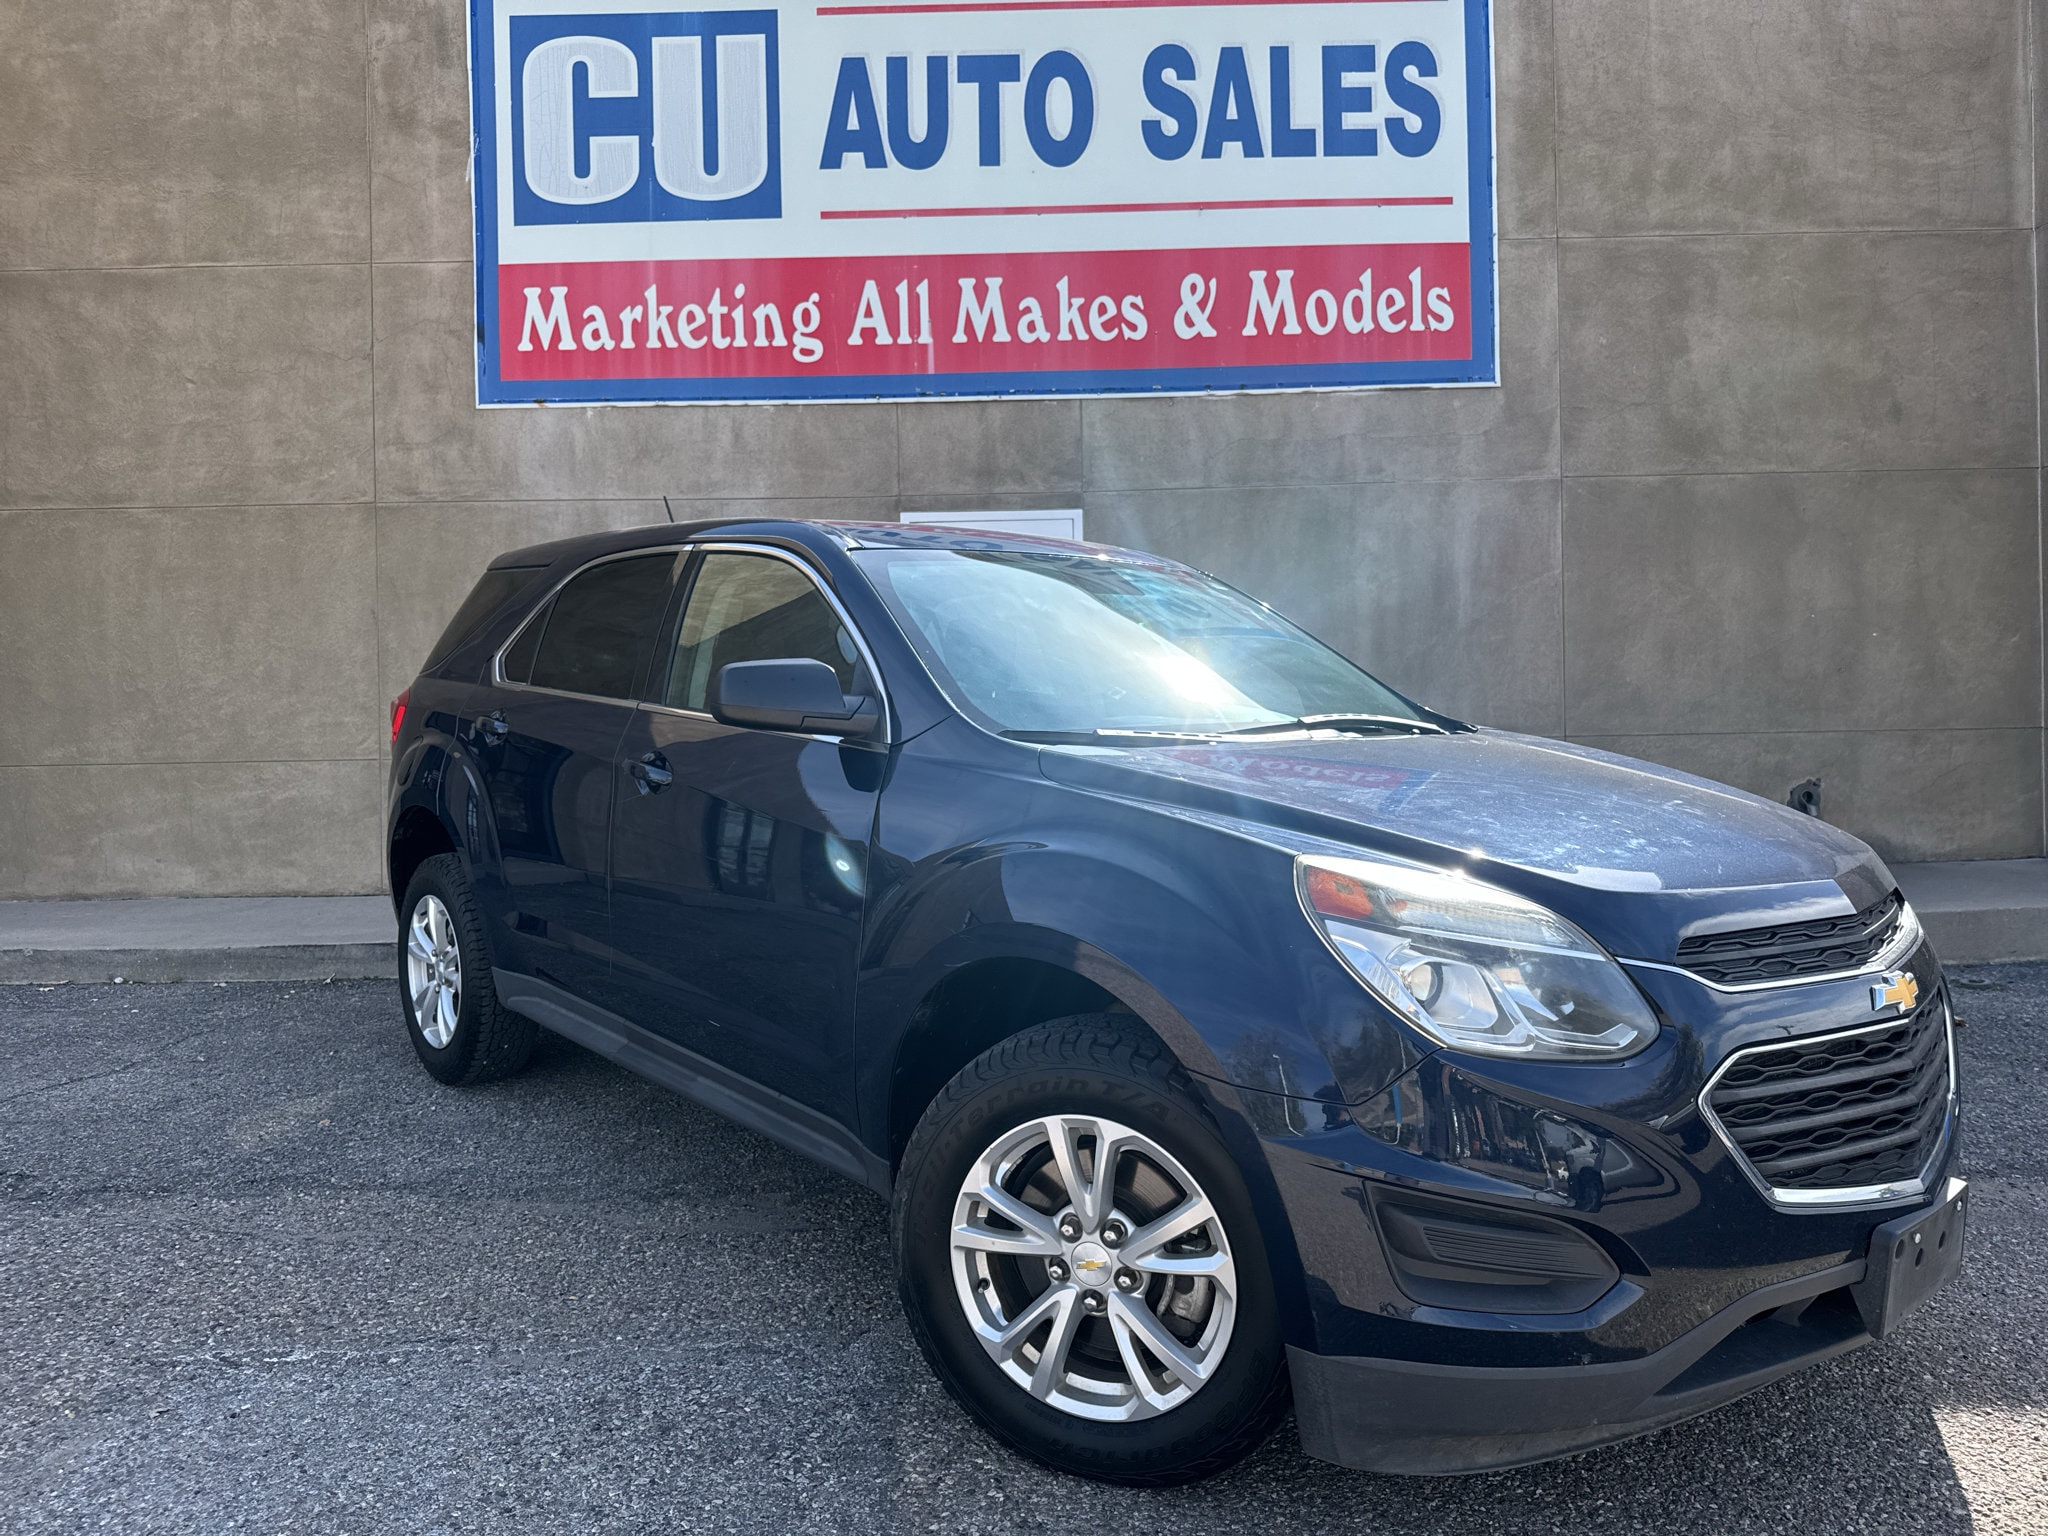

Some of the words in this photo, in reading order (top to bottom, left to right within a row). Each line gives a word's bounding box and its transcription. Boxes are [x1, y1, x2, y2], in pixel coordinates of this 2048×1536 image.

[522, 34, 769, 205] CU
[820, 51, 1094, 169] AUTO
[1142, 41, 1441, 160] SALES
[517, 283, 824, 363] Marketing
[847, 277, 931, 346] All
[952, 275, 1149, 344] Makes
[1173, 272, 1218, 340] &
[1242, 266, 1455, 336] Models
